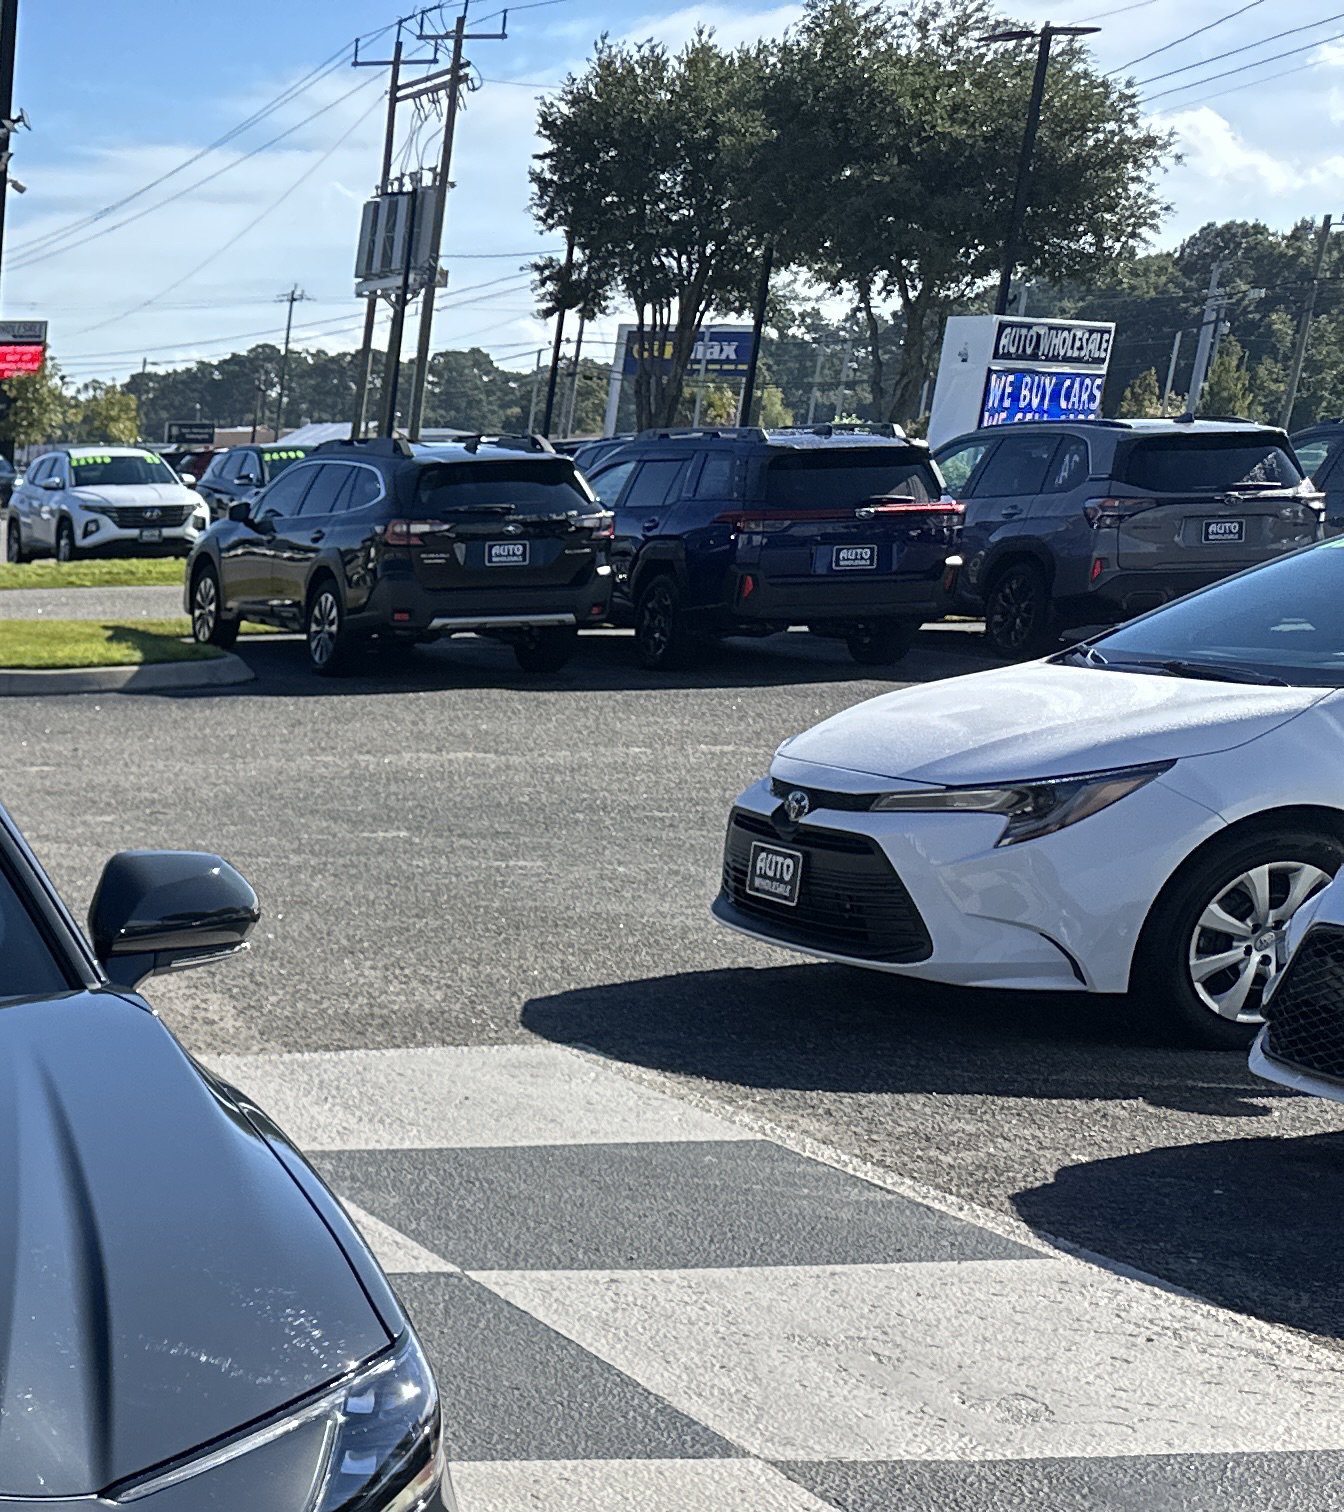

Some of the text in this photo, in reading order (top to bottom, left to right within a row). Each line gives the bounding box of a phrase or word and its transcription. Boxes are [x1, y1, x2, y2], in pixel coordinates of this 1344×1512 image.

[999, 325, 1110, 360] AUTO WHOLESALE
[988, 373, 1103, 411] WE BUY CARS
[1208, 522, 1240, 534] AUTO
[492, 545, 523, 557] AUTO
[839, 548, 871, 560] AUTO
[756, 852, 794, 881] AUTO
